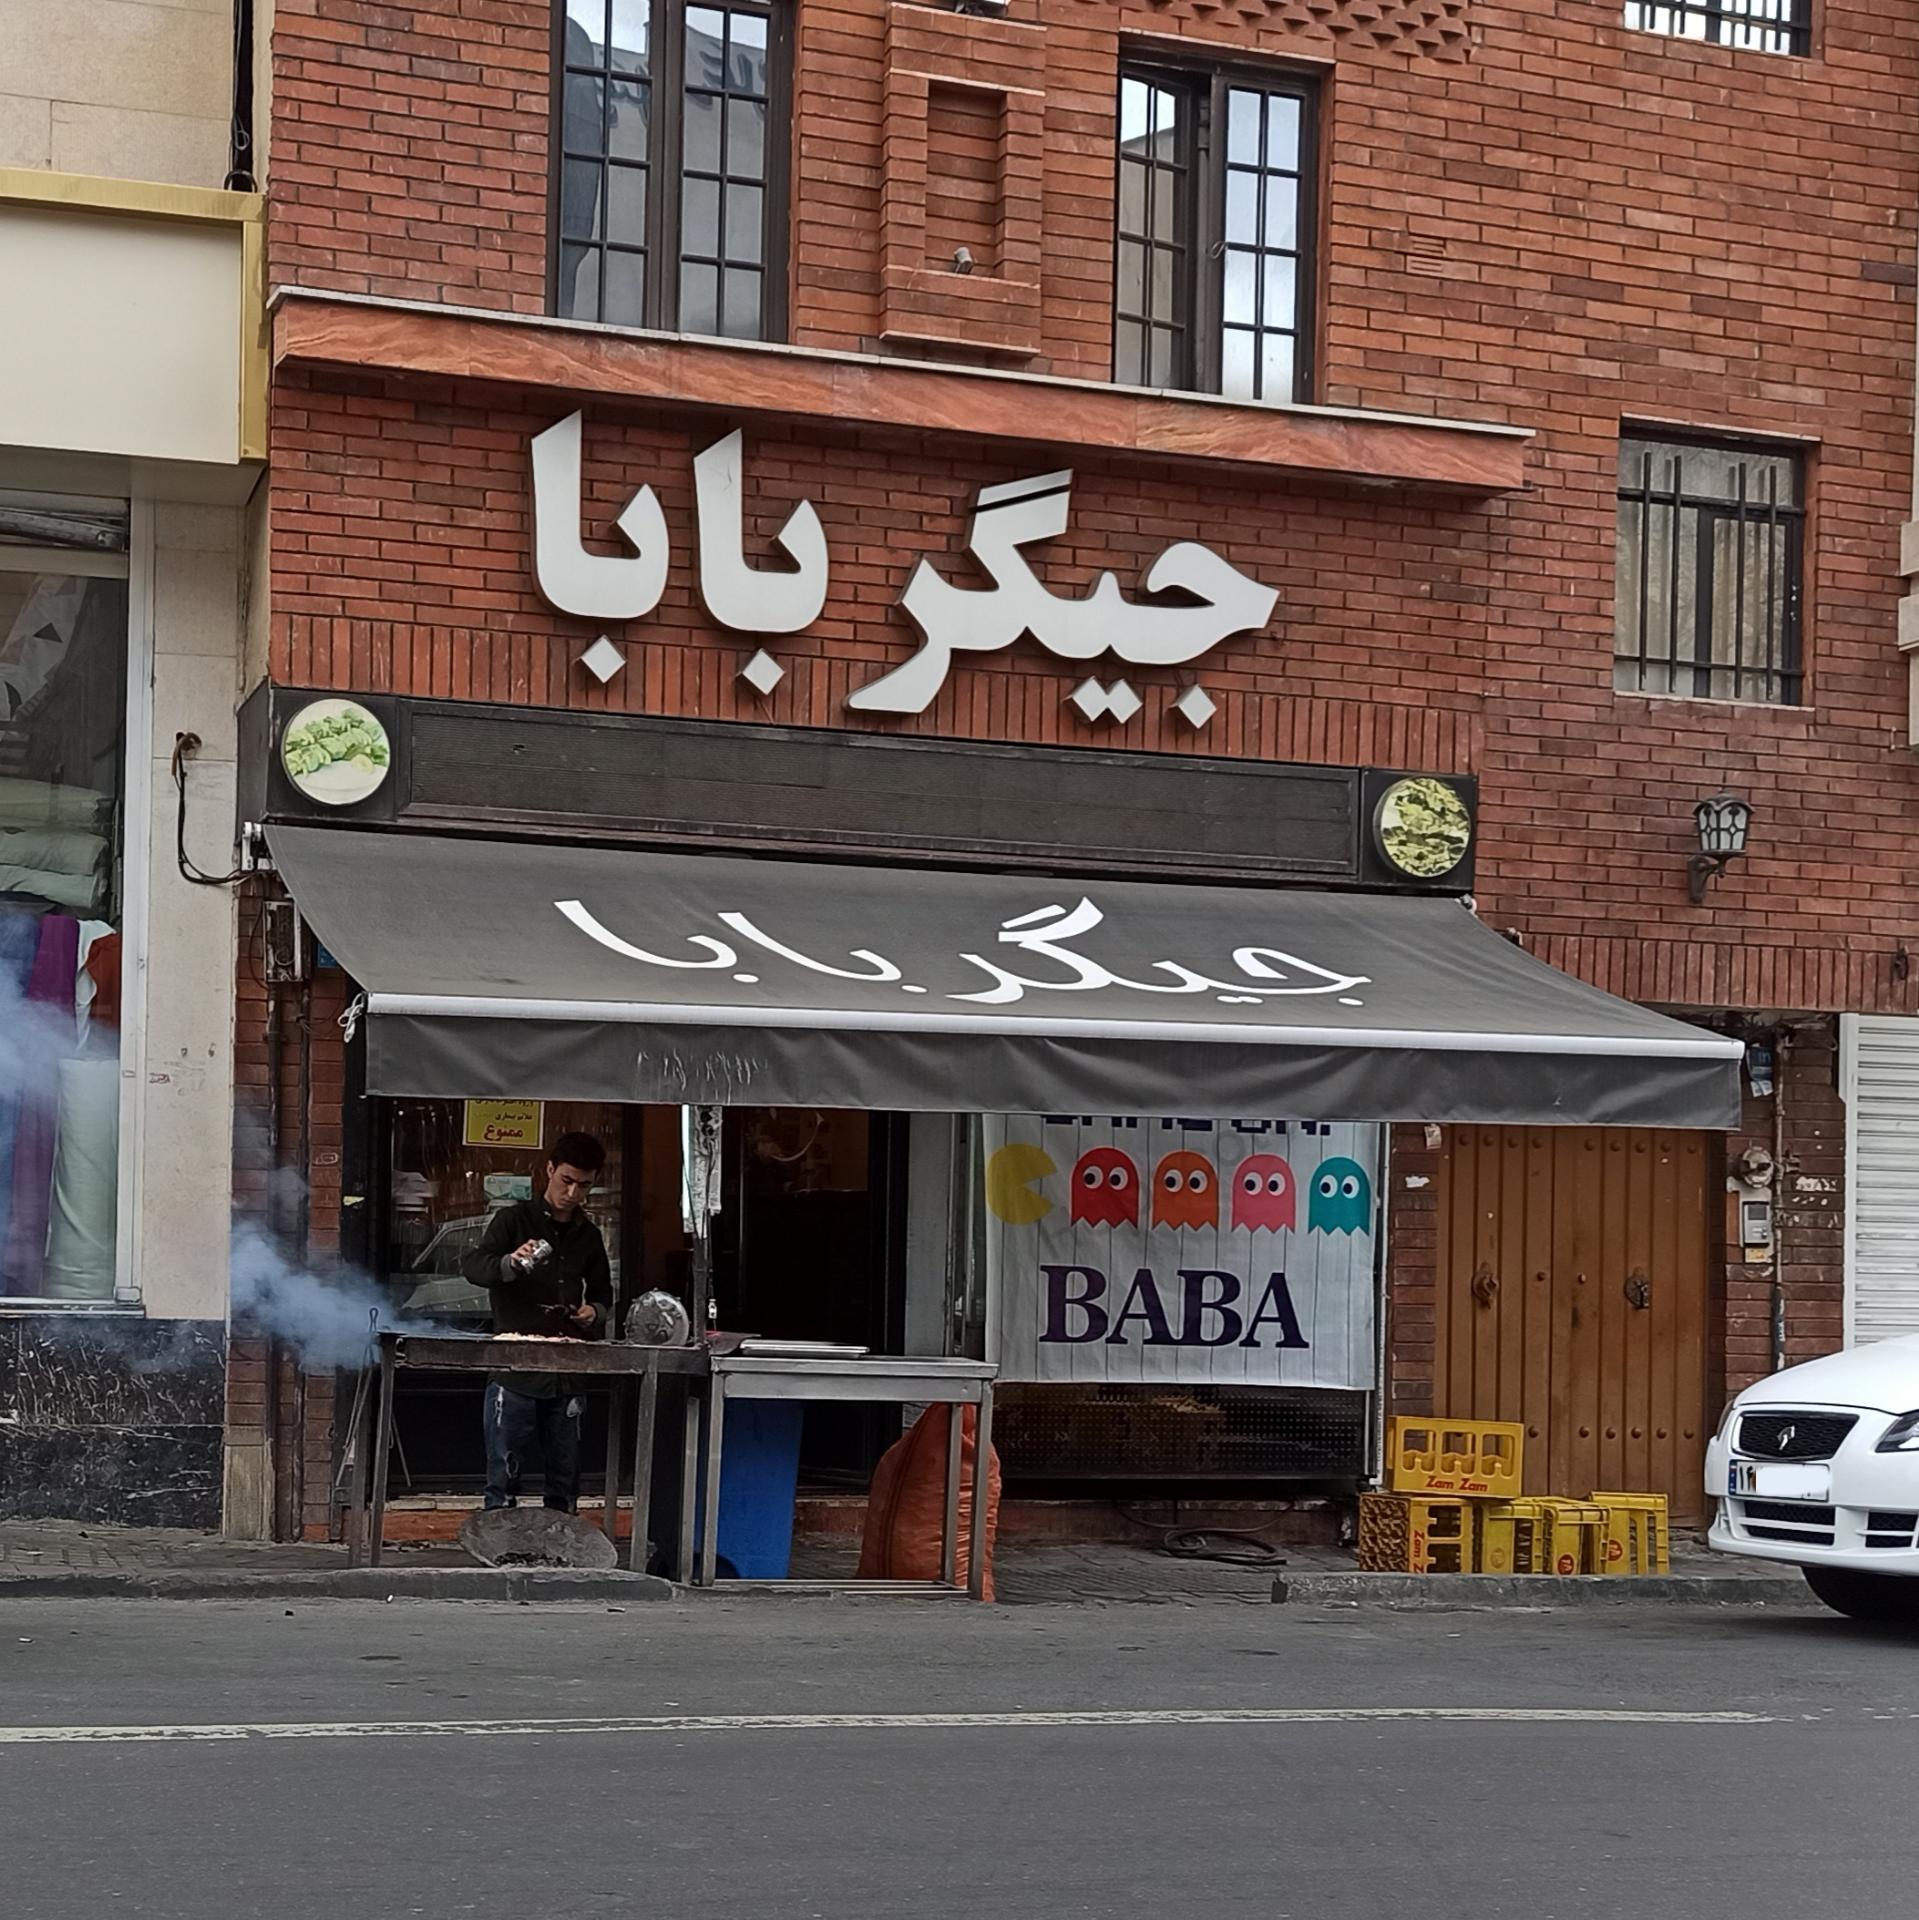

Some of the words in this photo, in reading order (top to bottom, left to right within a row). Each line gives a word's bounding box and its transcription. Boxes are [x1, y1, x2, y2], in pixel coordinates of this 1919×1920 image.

[530, 408, 829, 696] بابا
[847, 467, 1281, 730] جیگر
[553, 900, 927, 993] بابا
[946, 896, 1373, 1006] جیگر
[484, 1124, 523, 1141] ممنوع
[1038, 1264, 1310, 1349] BABA
[1425, 1475, 1455, 1490] Zam
[1459, 1477, 1489, 1493] Zam
